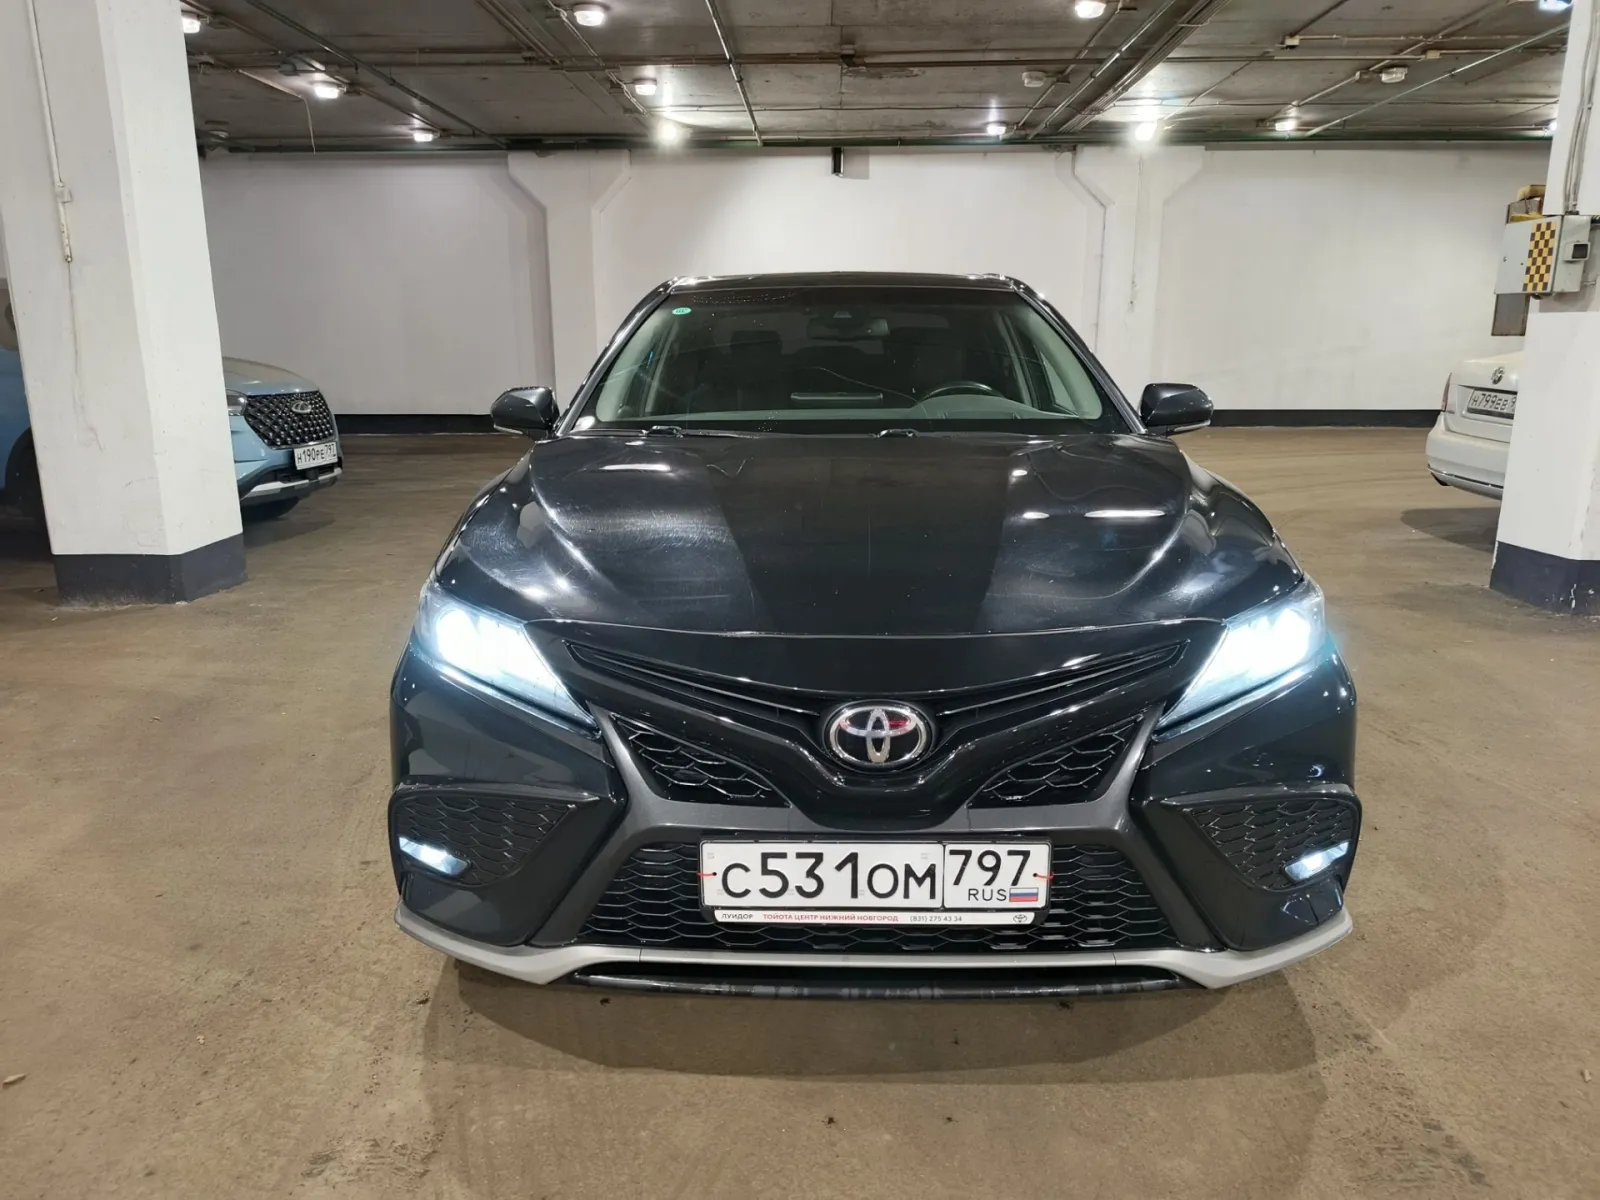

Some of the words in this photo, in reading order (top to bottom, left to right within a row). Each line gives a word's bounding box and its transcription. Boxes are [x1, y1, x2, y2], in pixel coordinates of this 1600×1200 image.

[721, 851, 937, 900] С531ОМ
[949, 849, 1031, 887] 797
[967, 888, 1007, 902] RUS
[763, 912, 793, 920] ТОЙОТА
[820, 913, 856, 921] НИЖНИЙ
[857, 914, 899, 922] НОВГОРОД
